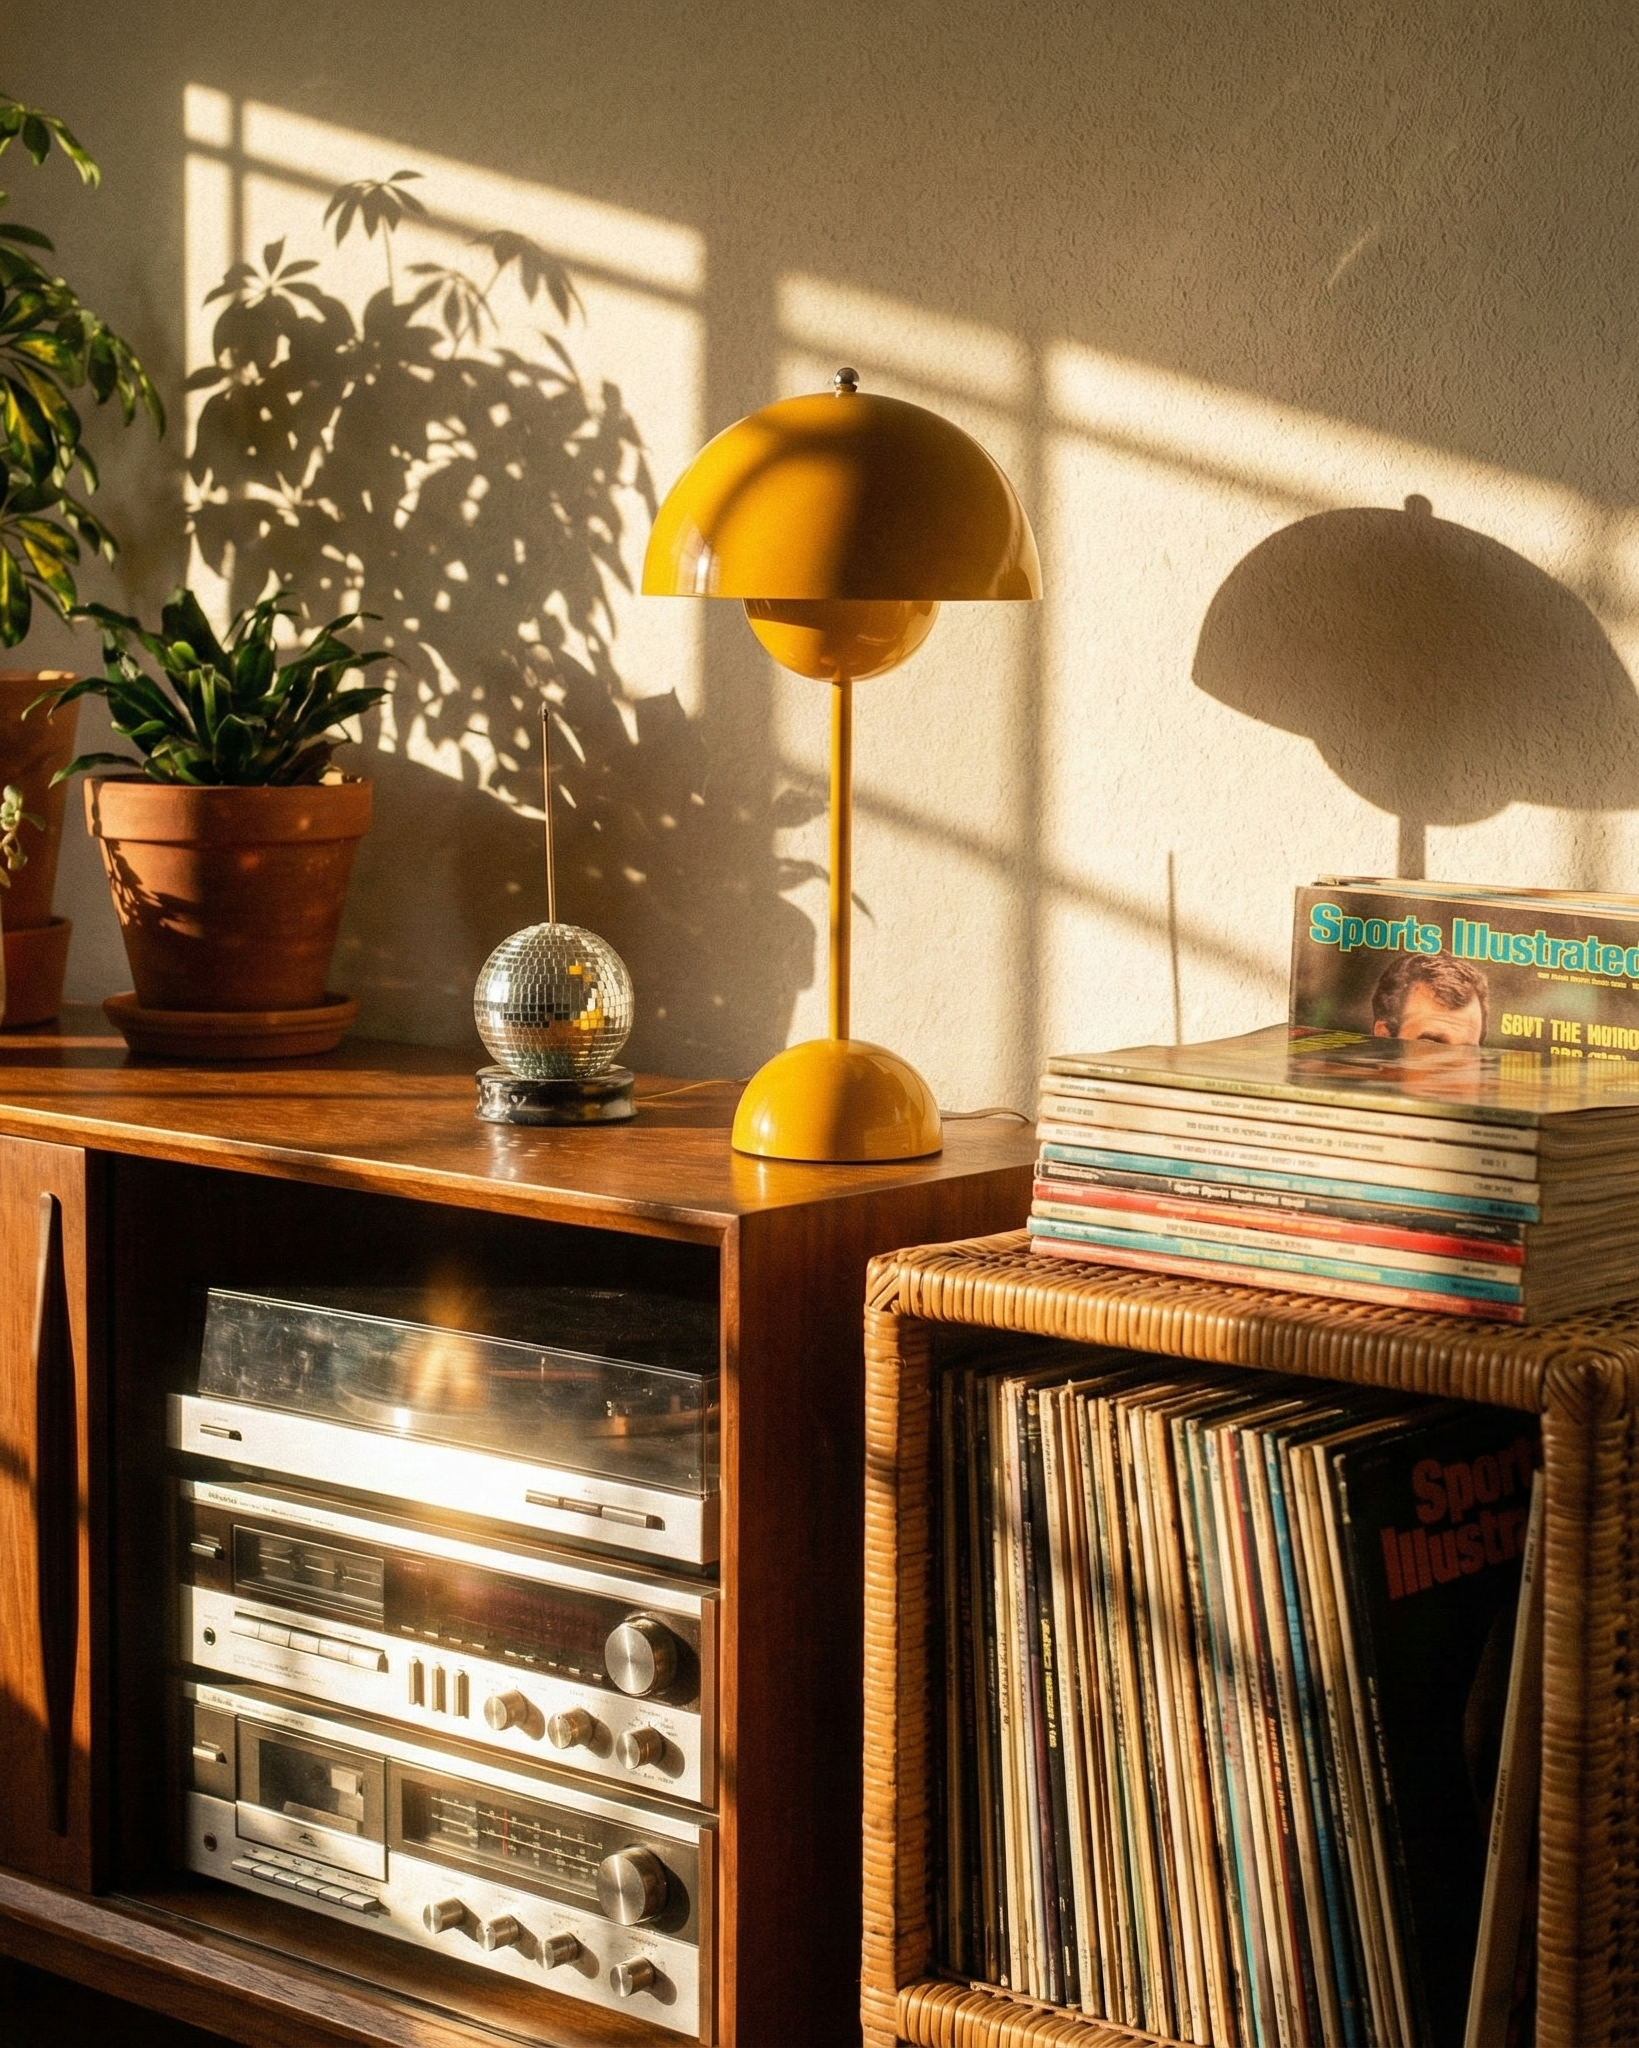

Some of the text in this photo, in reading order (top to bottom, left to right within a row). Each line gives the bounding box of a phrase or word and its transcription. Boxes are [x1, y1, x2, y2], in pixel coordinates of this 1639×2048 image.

[1310, 902, 1442, 955] Sports
[1550, 1018, 1582, 1044] THE
[1412, 1436, 1539, 1523] Sport
